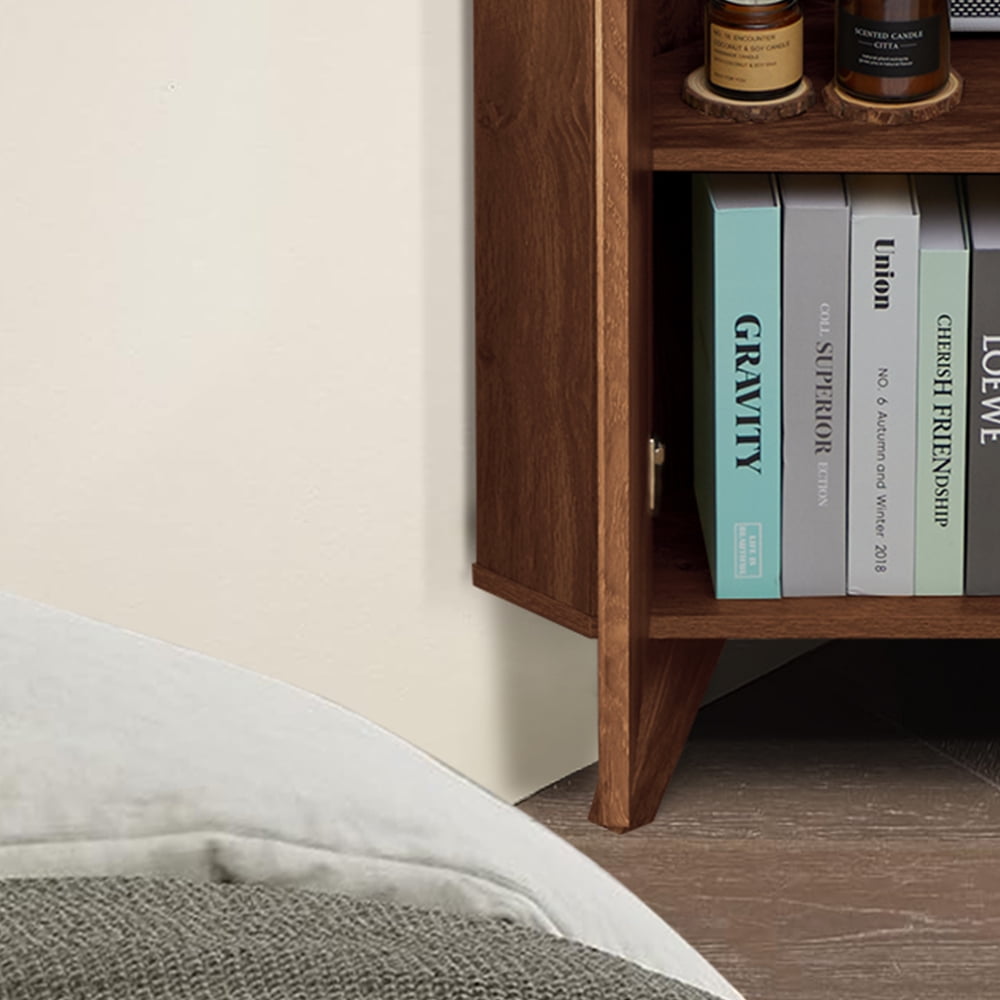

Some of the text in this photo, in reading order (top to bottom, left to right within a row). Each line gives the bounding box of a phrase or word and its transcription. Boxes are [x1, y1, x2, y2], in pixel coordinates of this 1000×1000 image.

[854, 26, 924, 41] SCENTED CANDLE
[874, 239, 895, 310] Union
[734, 314, 762, 475] GRAVITY
[814, 341, 834, 455] SUPERIOR
[932, 314, 953, 528] CHERISH FRIENDSHIP
[875, 367, 889, 573] NO. 6 Autumn and Winter 2018
